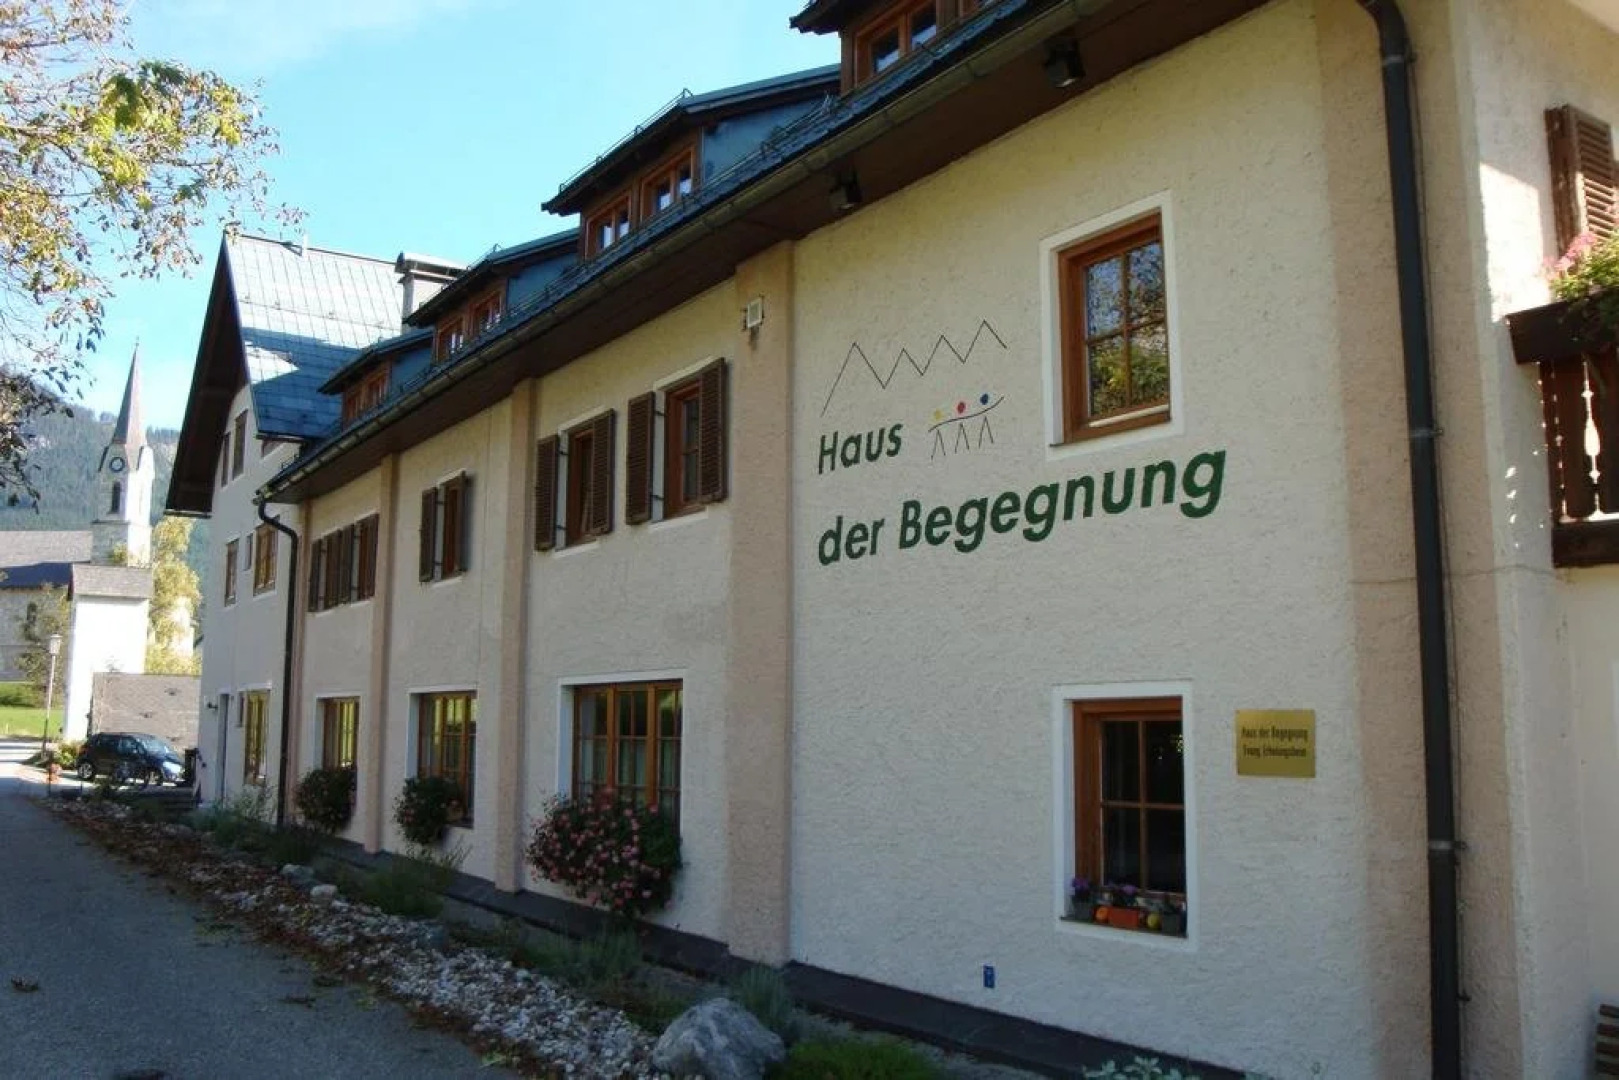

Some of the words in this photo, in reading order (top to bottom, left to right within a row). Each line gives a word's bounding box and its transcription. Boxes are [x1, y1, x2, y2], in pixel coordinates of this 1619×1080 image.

[818, 423, 903, 475] Haus
[818, 515, 885, 566] der
[899, 449, 1227, 554] Begegnung
